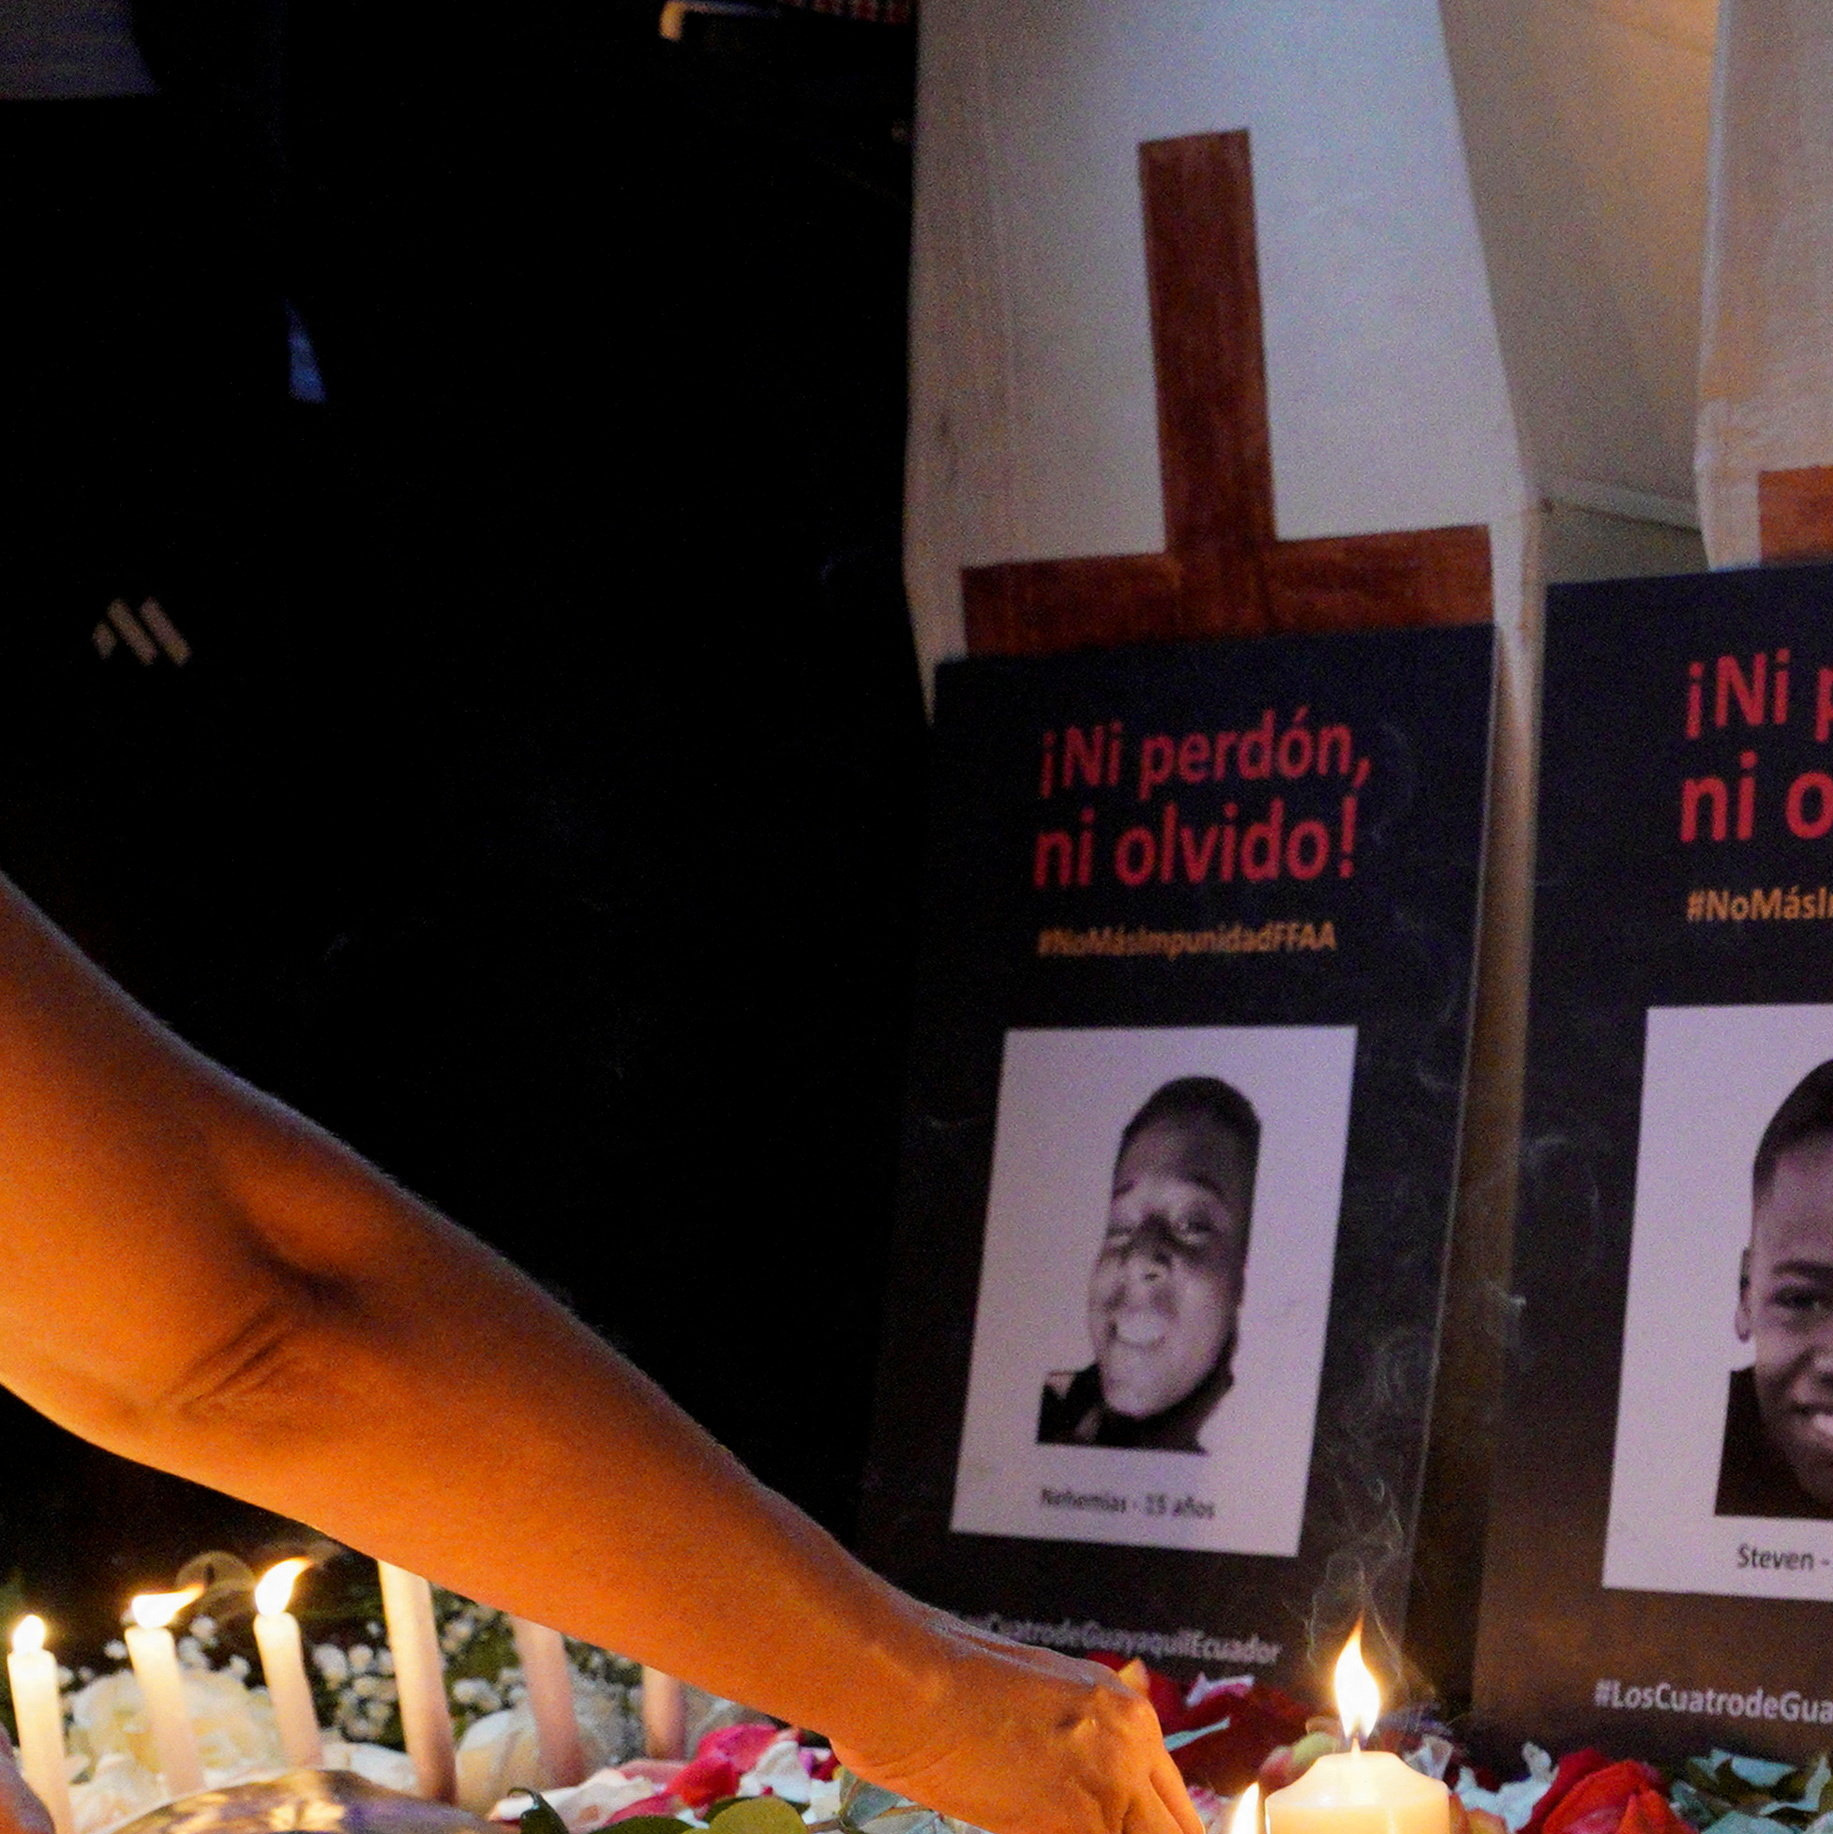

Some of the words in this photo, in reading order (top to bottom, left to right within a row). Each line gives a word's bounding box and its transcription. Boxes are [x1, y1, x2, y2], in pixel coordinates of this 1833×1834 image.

[1686, 648, 1790, 739] ¡Ni
[1040, 721, 1122, 798] ¡Ni
[1138, 705, 1372, 800] perdón,
[1680, 750, 1758, 843] ni
[1032, 808, 1095, 887] ni
[1114, 796, 1358, 886] olvido!
[1736, 1543, 1814, 1571] Steven
